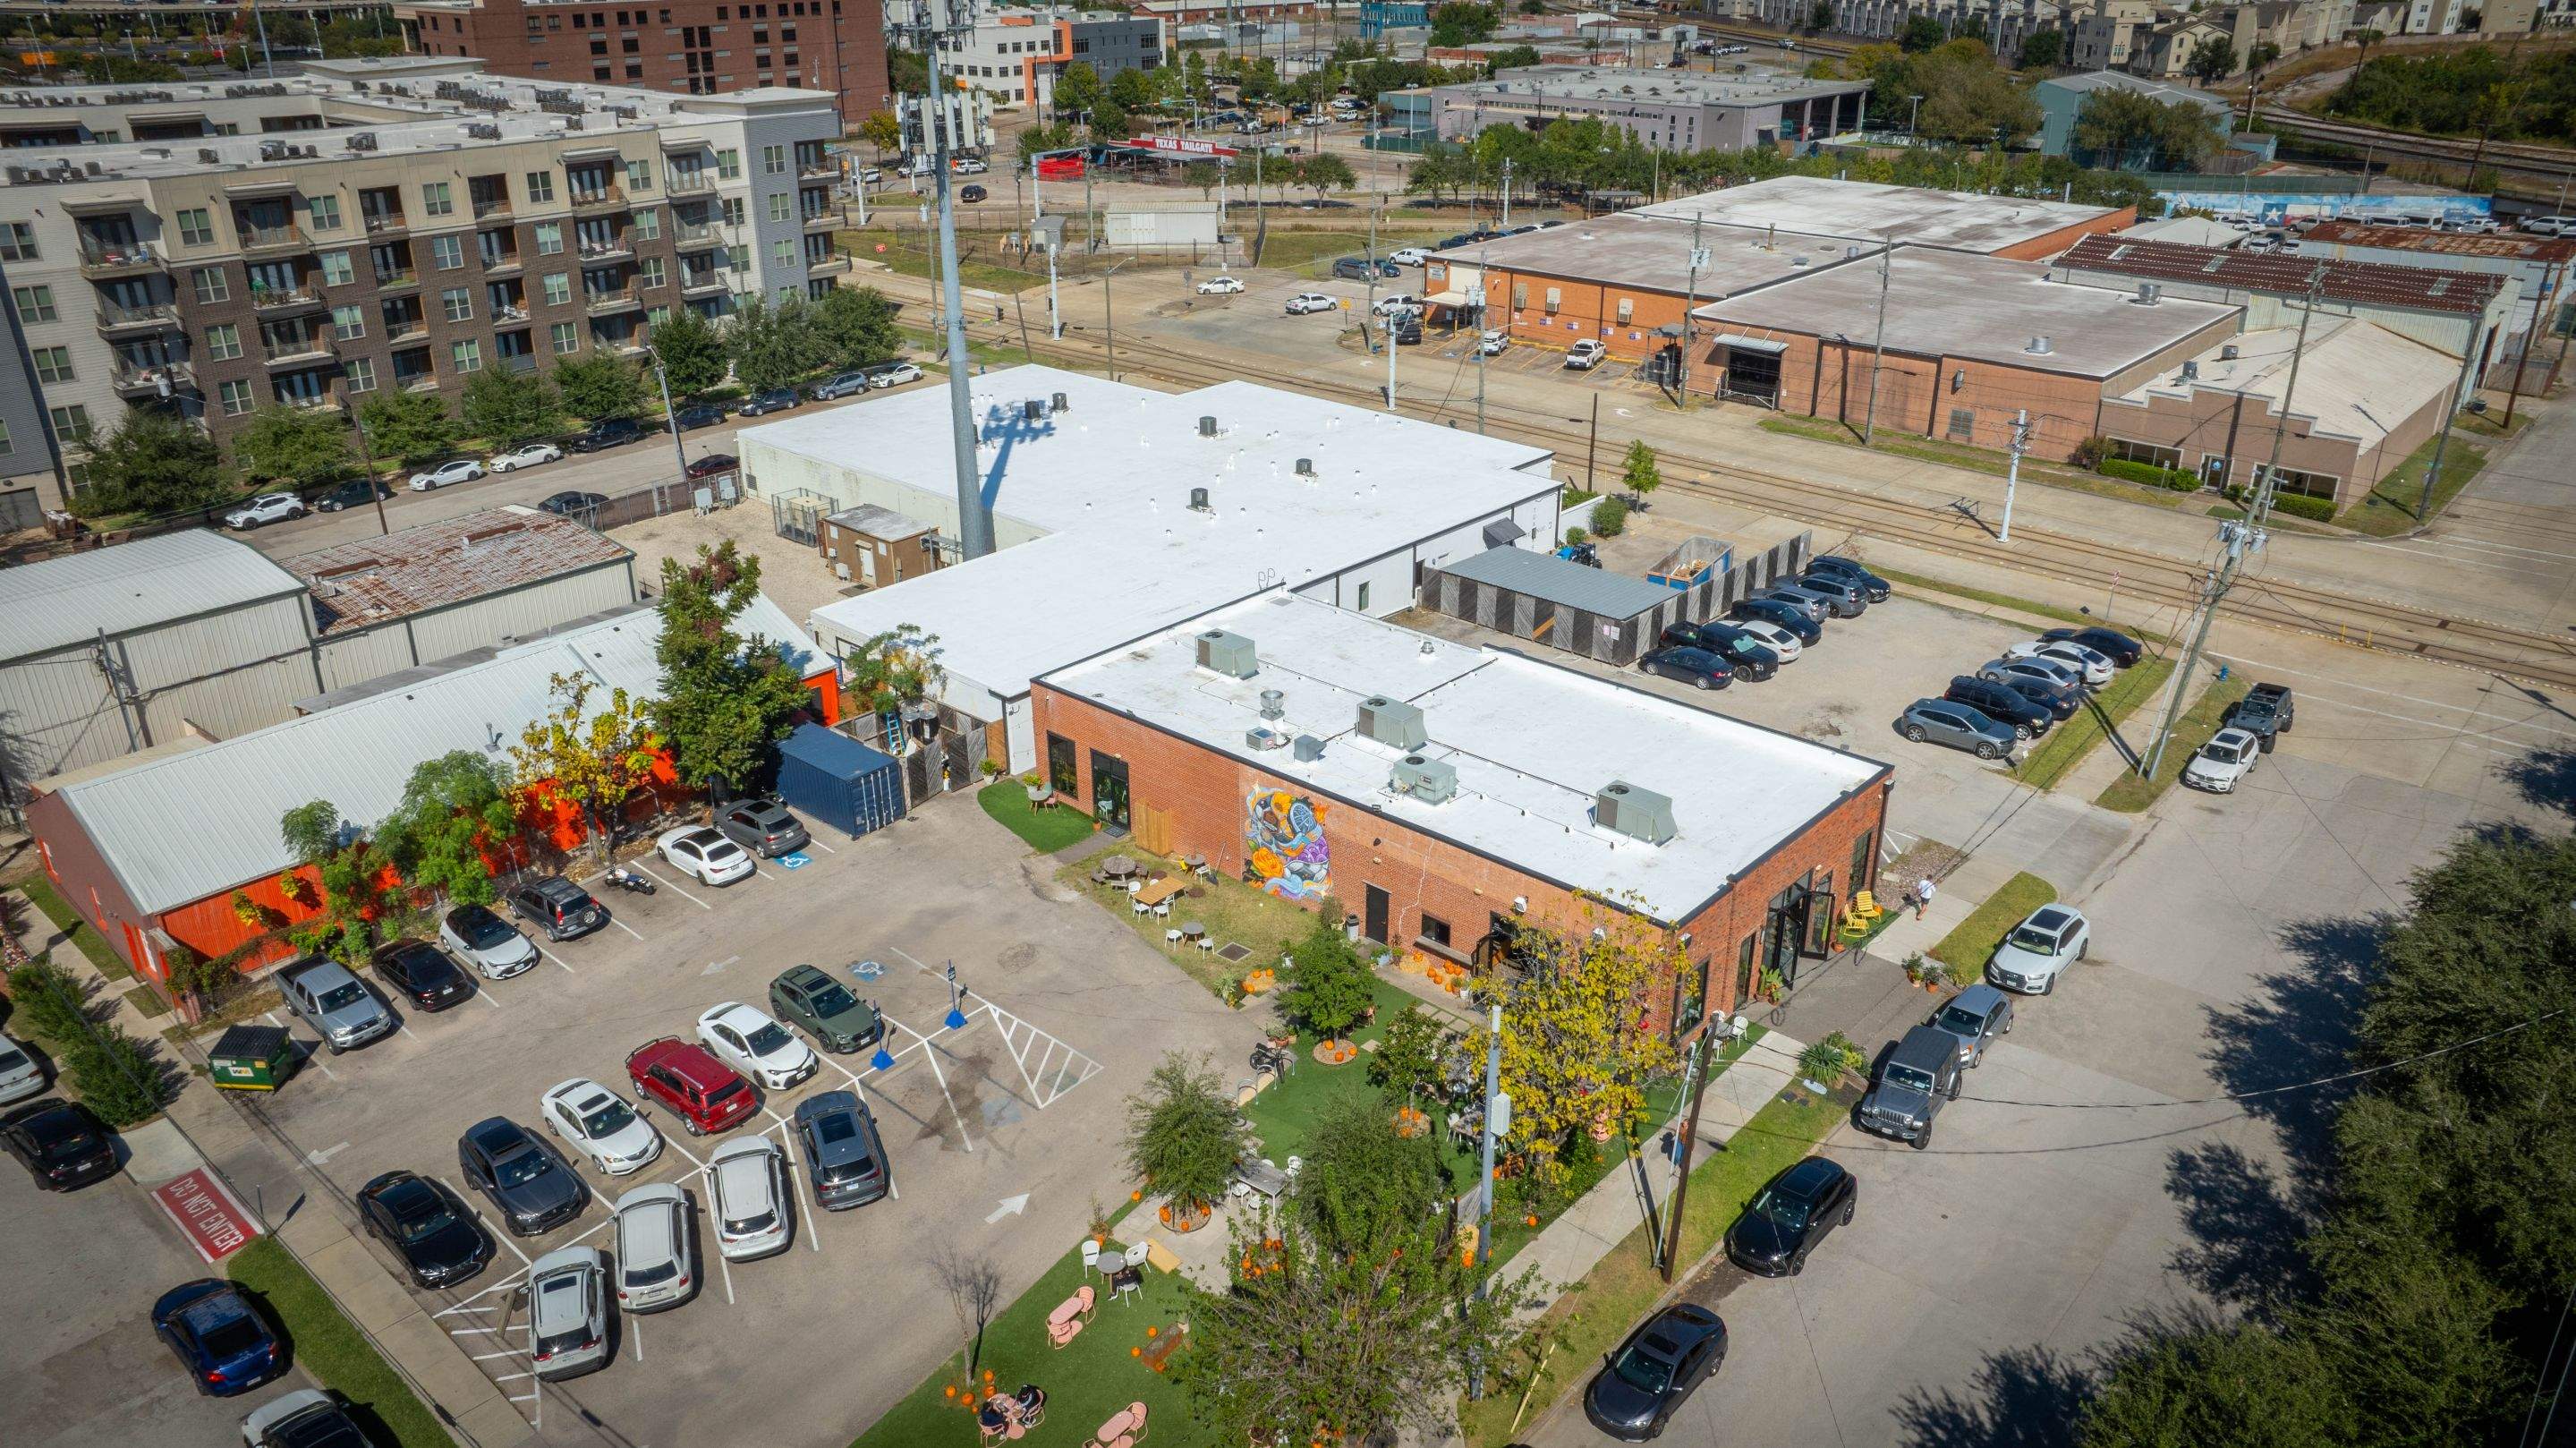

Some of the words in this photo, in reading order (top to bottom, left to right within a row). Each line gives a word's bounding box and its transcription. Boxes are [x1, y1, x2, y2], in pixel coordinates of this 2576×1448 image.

[1155, 138, 1177, 149] TEXAS
[1180, 141, 1213, 153] TAILGATE
[168, 1177, 200, 1198] DO
[181, 1191, 217, 1218] NOT
[198, 1212, 245, 1252] ENTER
